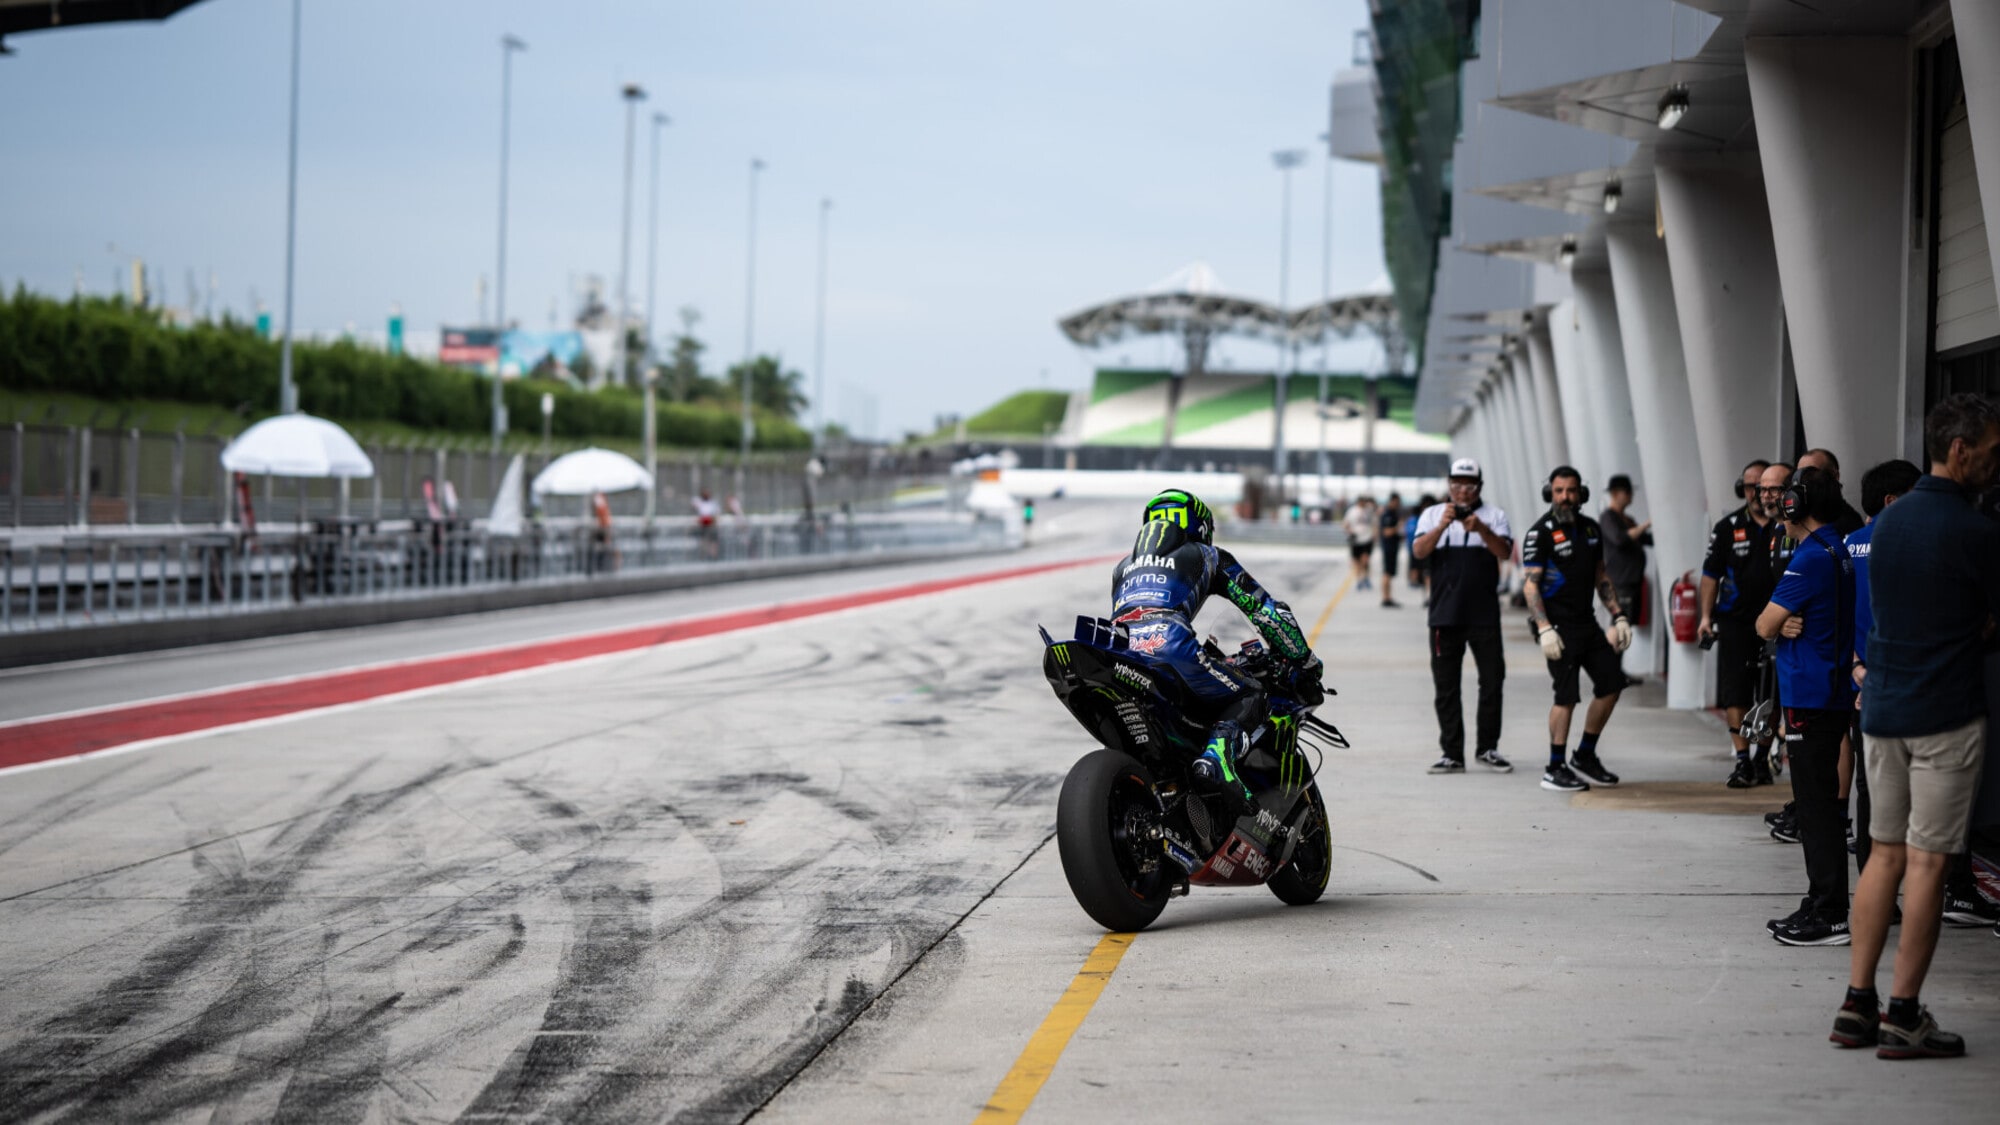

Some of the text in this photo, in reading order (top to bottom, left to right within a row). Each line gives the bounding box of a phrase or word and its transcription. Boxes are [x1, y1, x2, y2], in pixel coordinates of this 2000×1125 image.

[1122, 554, 1176, 578] YAMAHA
[1121, 573, 1168, 594] prima
[1114, 661, 1152, 689] MONSTER
[1134, 734, 1149, 745] 2D
